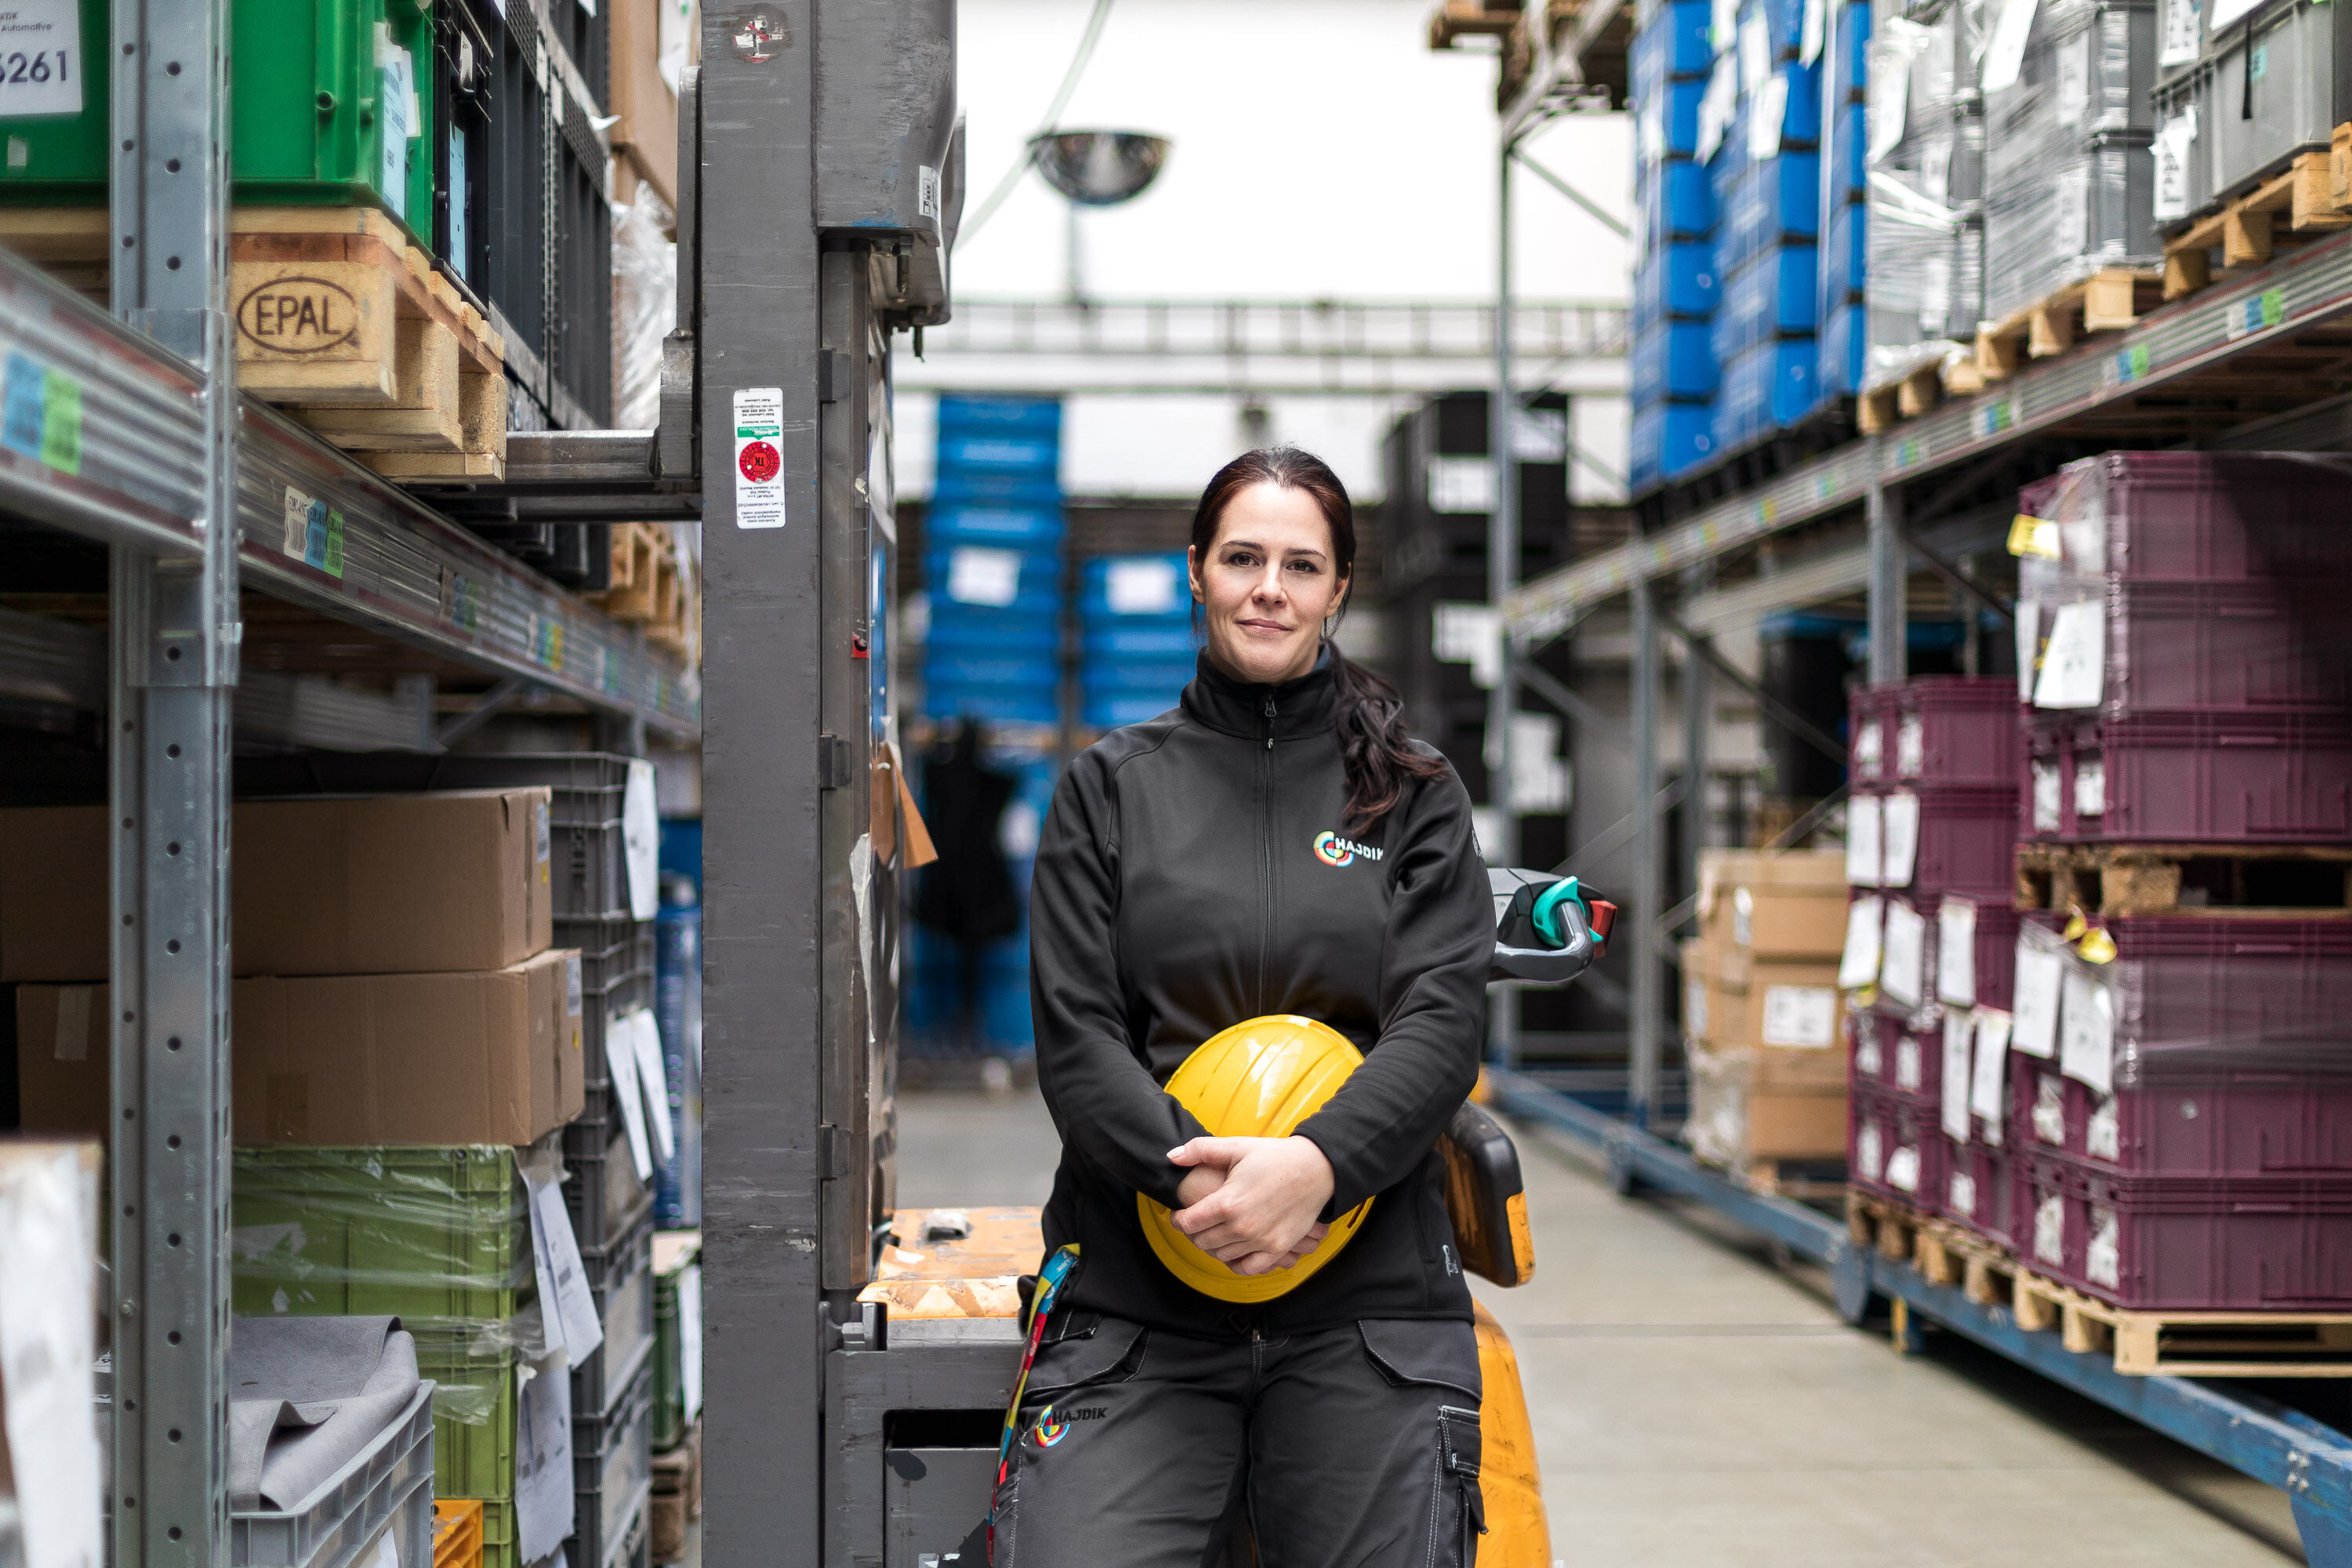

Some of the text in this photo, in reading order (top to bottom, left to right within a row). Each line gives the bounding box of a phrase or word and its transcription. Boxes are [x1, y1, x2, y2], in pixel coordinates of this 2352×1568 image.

[1, 22, 52, 32] Automotive
[0, 51, 67, 83] 261
[256, 295, 342, 336] EPAL
[1053, 1407, 1109, 1424] HAJDIK
